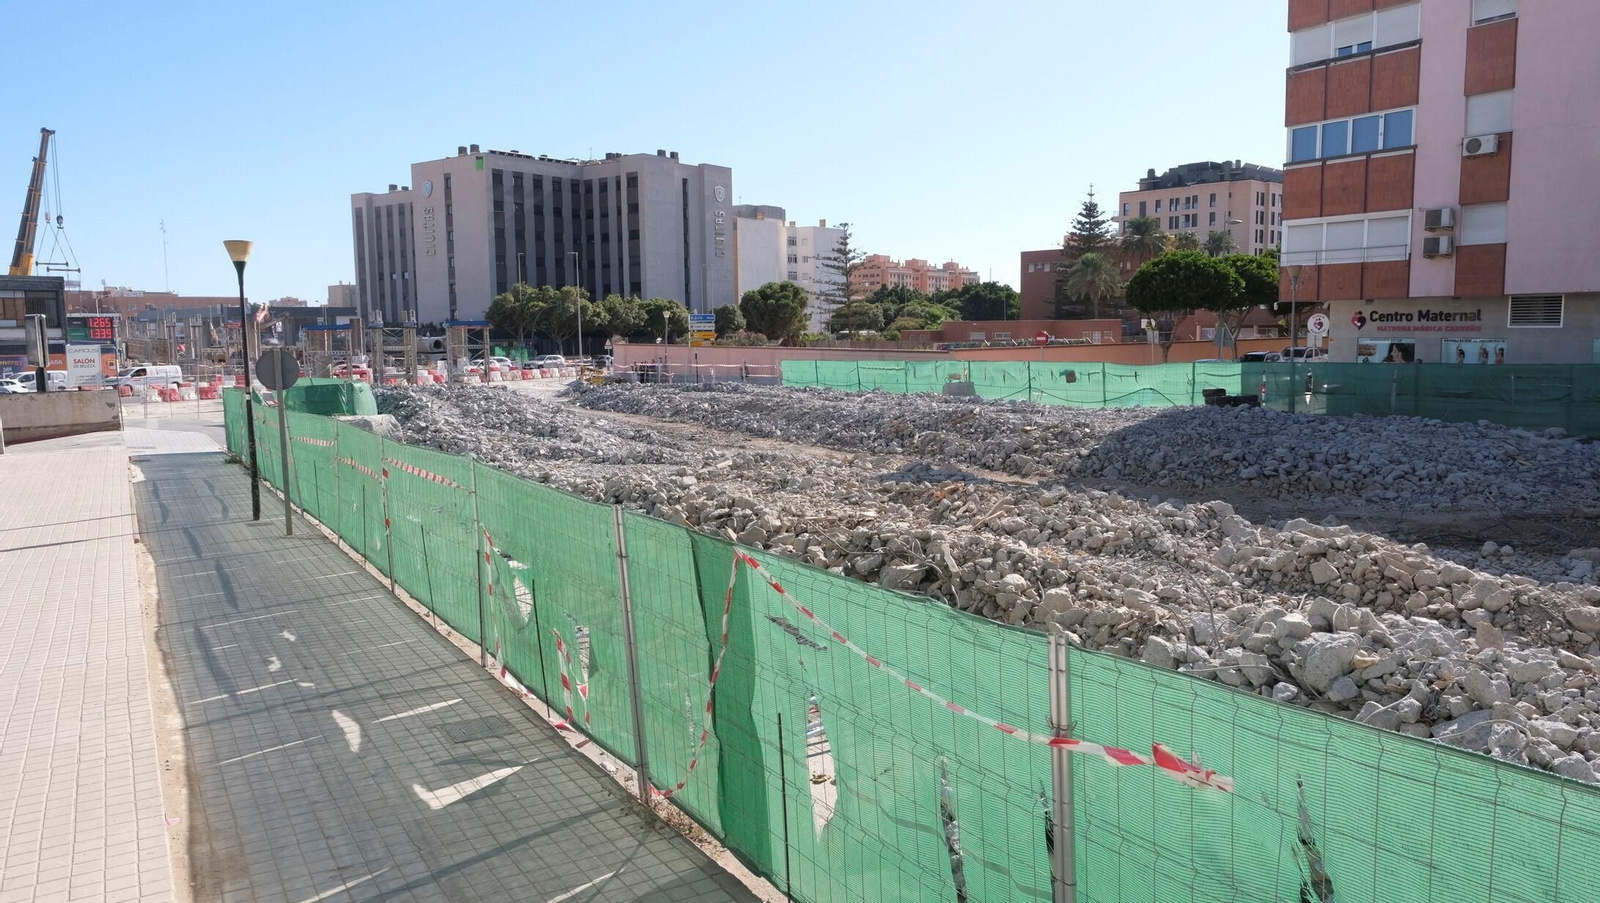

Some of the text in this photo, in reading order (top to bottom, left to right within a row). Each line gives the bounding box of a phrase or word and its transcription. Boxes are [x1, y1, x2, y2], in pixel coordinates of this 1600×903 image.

[1369, 309, 1482, 322] Centro Maternal
[1413, 324, 1443, 332] MÓNICA
